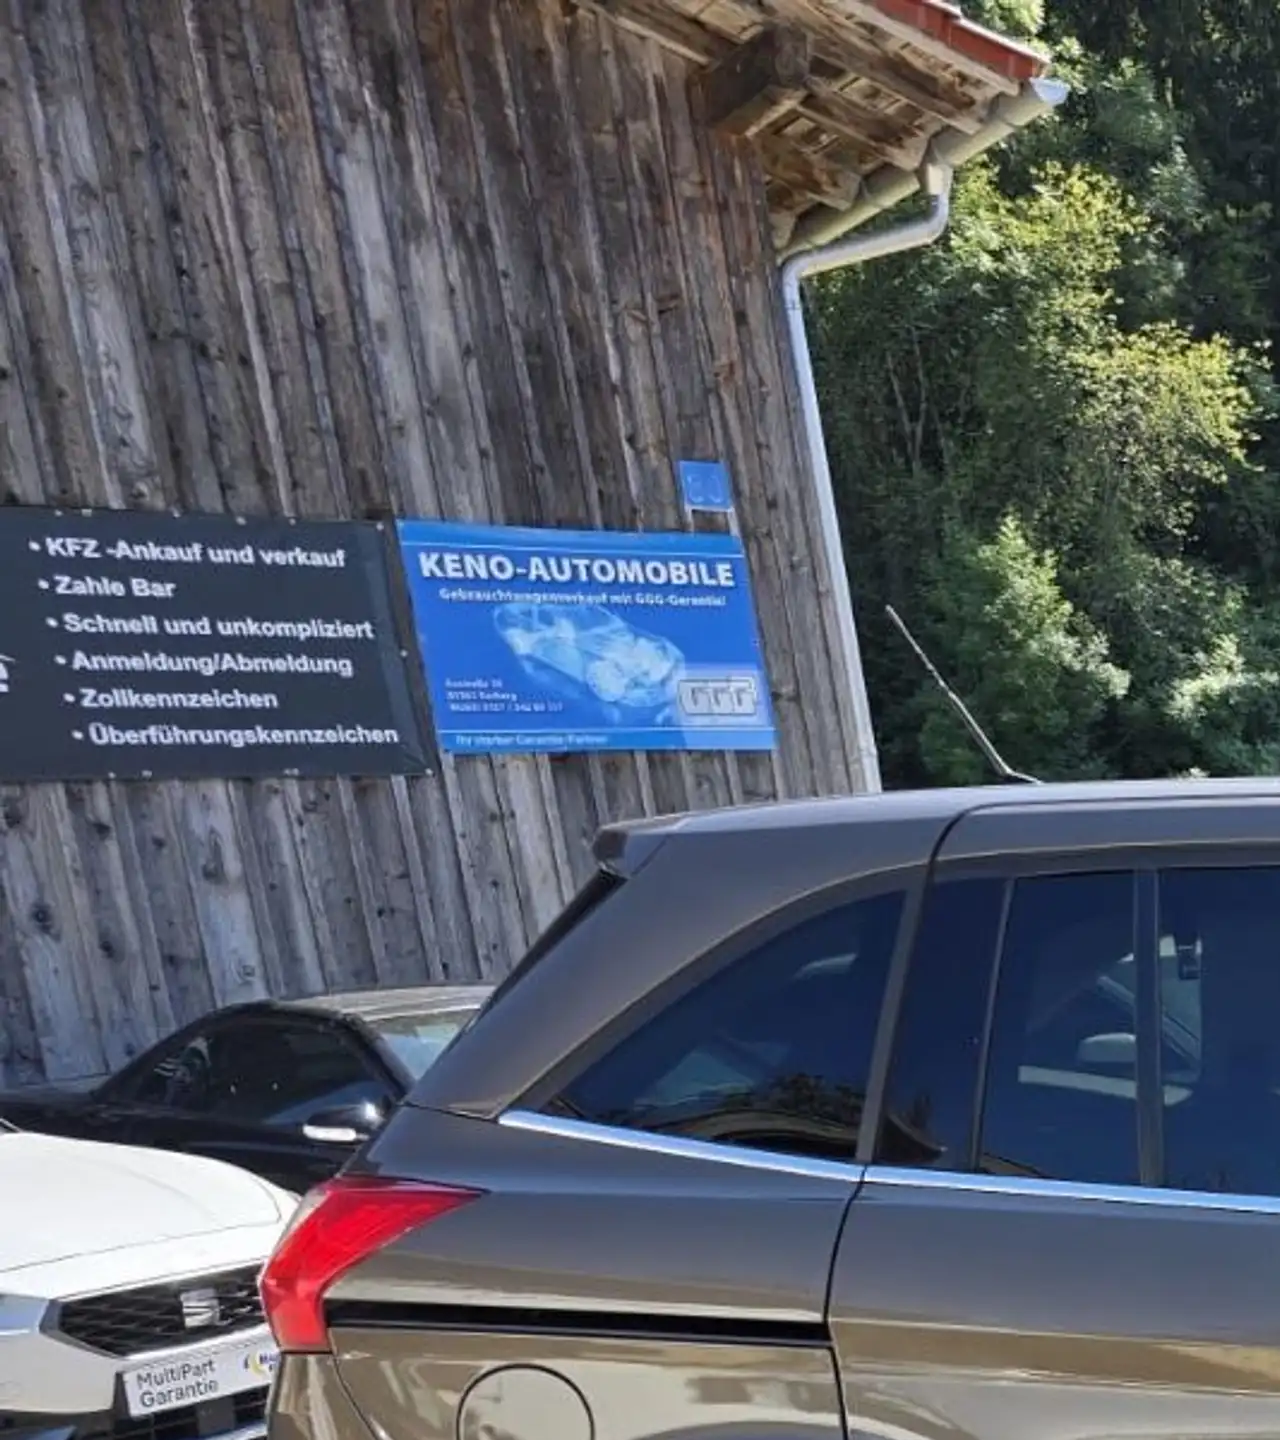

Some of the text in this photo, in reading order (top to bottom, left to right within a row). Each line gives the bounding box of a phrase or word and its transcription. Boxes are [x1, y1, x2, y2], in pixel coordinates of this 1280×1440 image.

[45, 537, 102, 558] KFZ
[208, 545, 255, 565] und
[259, 546, 346, 567] verkauf
[419, 552, 735, 587] KENO-AUTOMOBILE
[53, 575, 176, 598] Zahle Bar
[63, 612, 375, 641] Schnell und unkompliziert
[72, 650, 354, 678] Anmeldung/Abmeldung
[80, 688, 279, 708] Zollkennzeichen
[136, 1358, 216, 1391] MultiPart
[139, 1378, 220, 1409] Garantie
